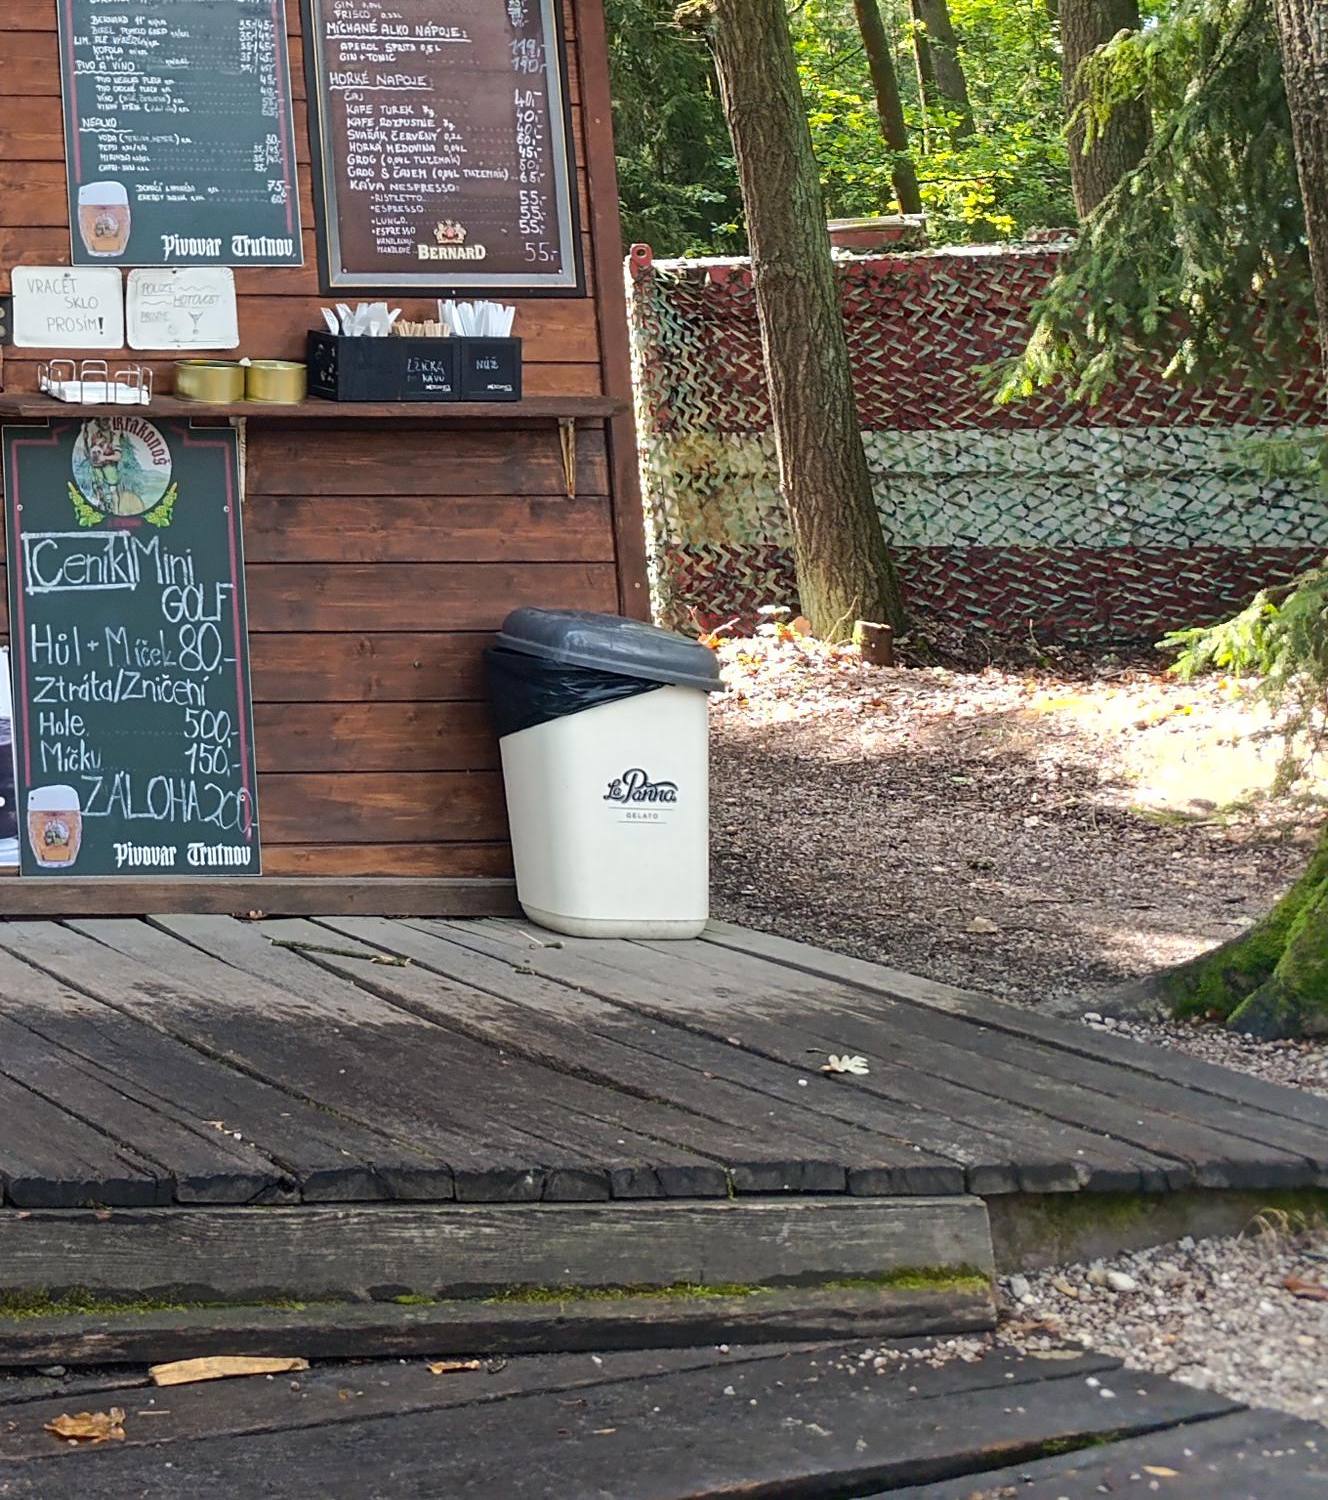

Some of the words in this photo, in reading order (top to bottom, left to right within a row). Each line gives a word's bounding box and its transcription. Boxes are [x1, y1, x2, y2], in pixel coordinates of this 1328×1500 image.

[381, 22, 409, 35] ALKO
[329, 72, 369, 86] HORKÉ
[380, 105, 414, 114] TUREK
[160, 233, 222, 261] Pivovar
[418, 245, 486, 260] BERNARD
[64, 296, 99, 310] SKLO
[32, 536, 130, 585] Ceník
[130, 536, 194, 585] Mini
[161, 583, 234, 623] GOLF
[30, 623, 80, 666] Hůl
[104, 625, 176, 667] Míček
[42, 740, 102, 772] Míčku
[81, 769, 205, 824] ZÁLOHA
[113, 841, 177, 868] Pivovar
[187, 842, 251, 866] Trutnov
